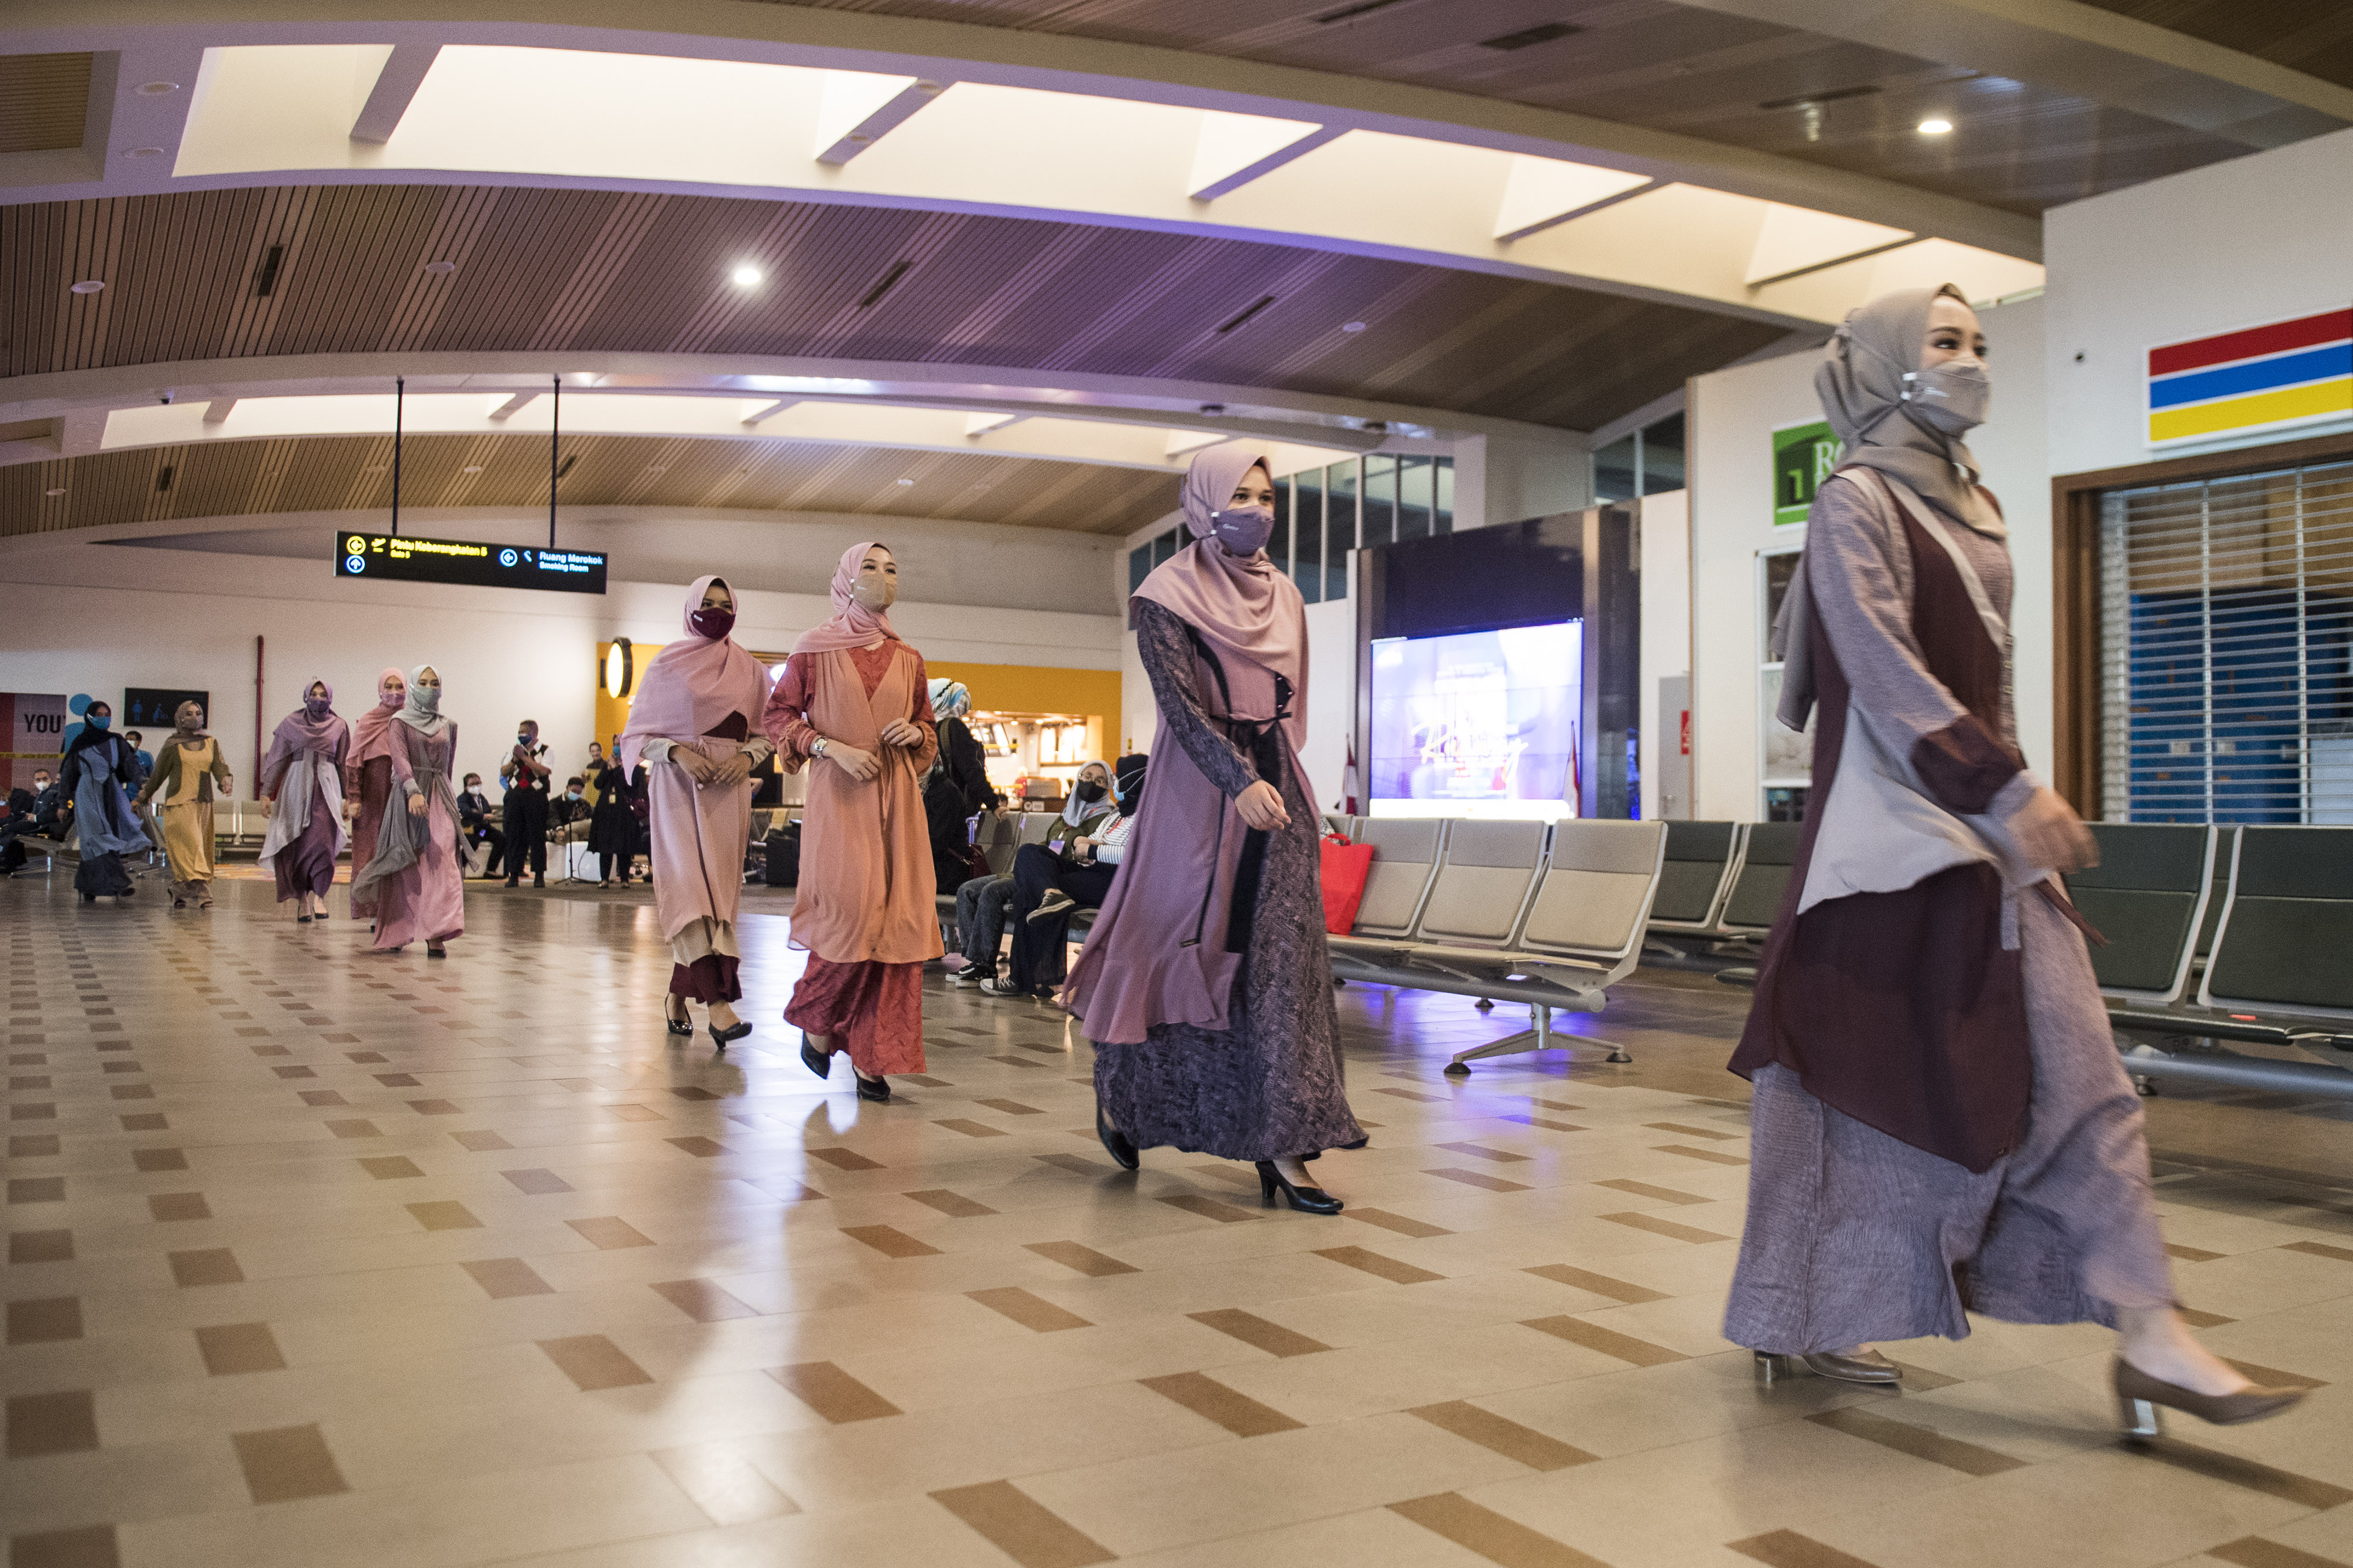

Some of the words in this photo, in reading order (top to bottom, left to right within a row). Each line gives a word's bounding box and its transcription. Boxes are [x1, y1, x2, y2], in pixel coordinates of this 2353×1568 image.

[391, 539, 415, 551] Pintu
[539, 551, 566, 563] Ruang
[568, 553, 603, 565] Merokok
[539, 561, 568, 572] Smoking
[569, 563, 589, 572] Room
[24, 713, 66, 733] YOU
